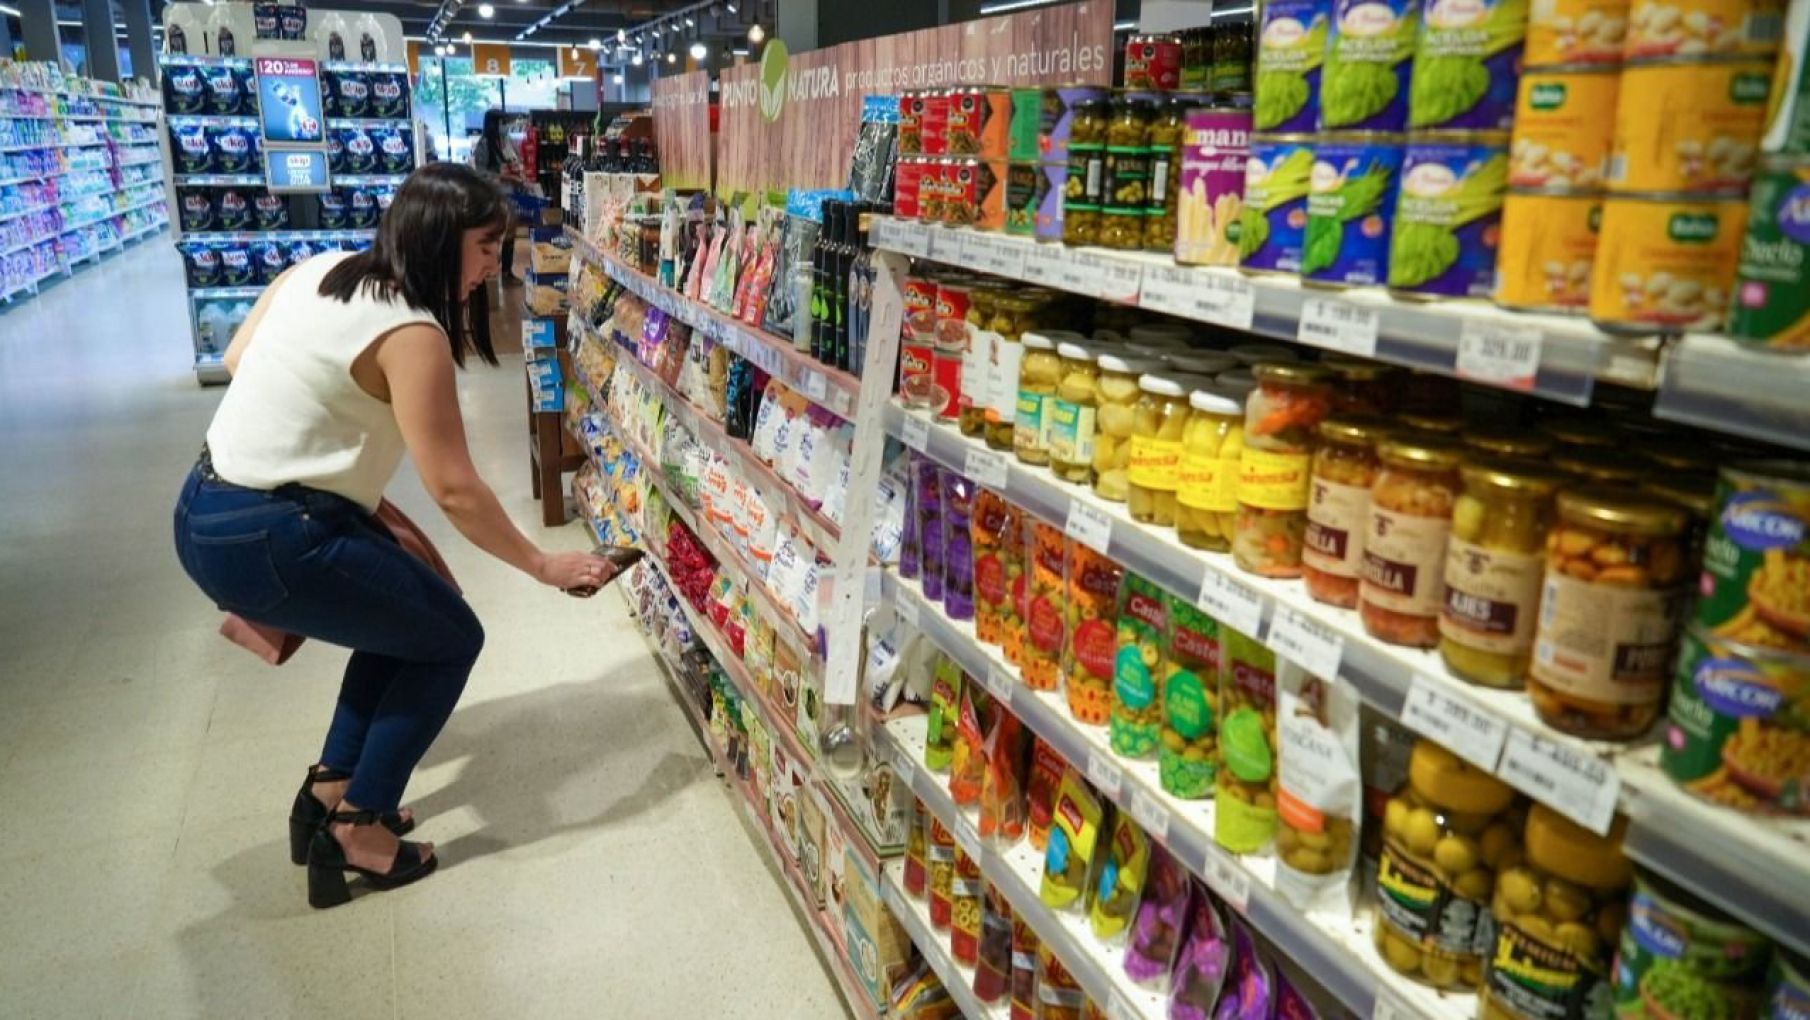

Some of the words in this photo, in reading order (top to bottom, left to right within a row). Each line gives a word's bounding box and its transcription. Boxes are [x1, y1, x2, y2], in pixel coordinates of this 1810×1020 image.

[487, 59, 499, 73] 8
[575, 63, 586, 76] 7
[722, 80, 758, 107] PUNTO
[787, 67, 839, 101] NATURA
[845, 65, 908, 91] productos
[912, 52, 986, 87] orgánicos
[991, 56, 1001, 82] y
[1007, 32, 1105, 77] naturales
